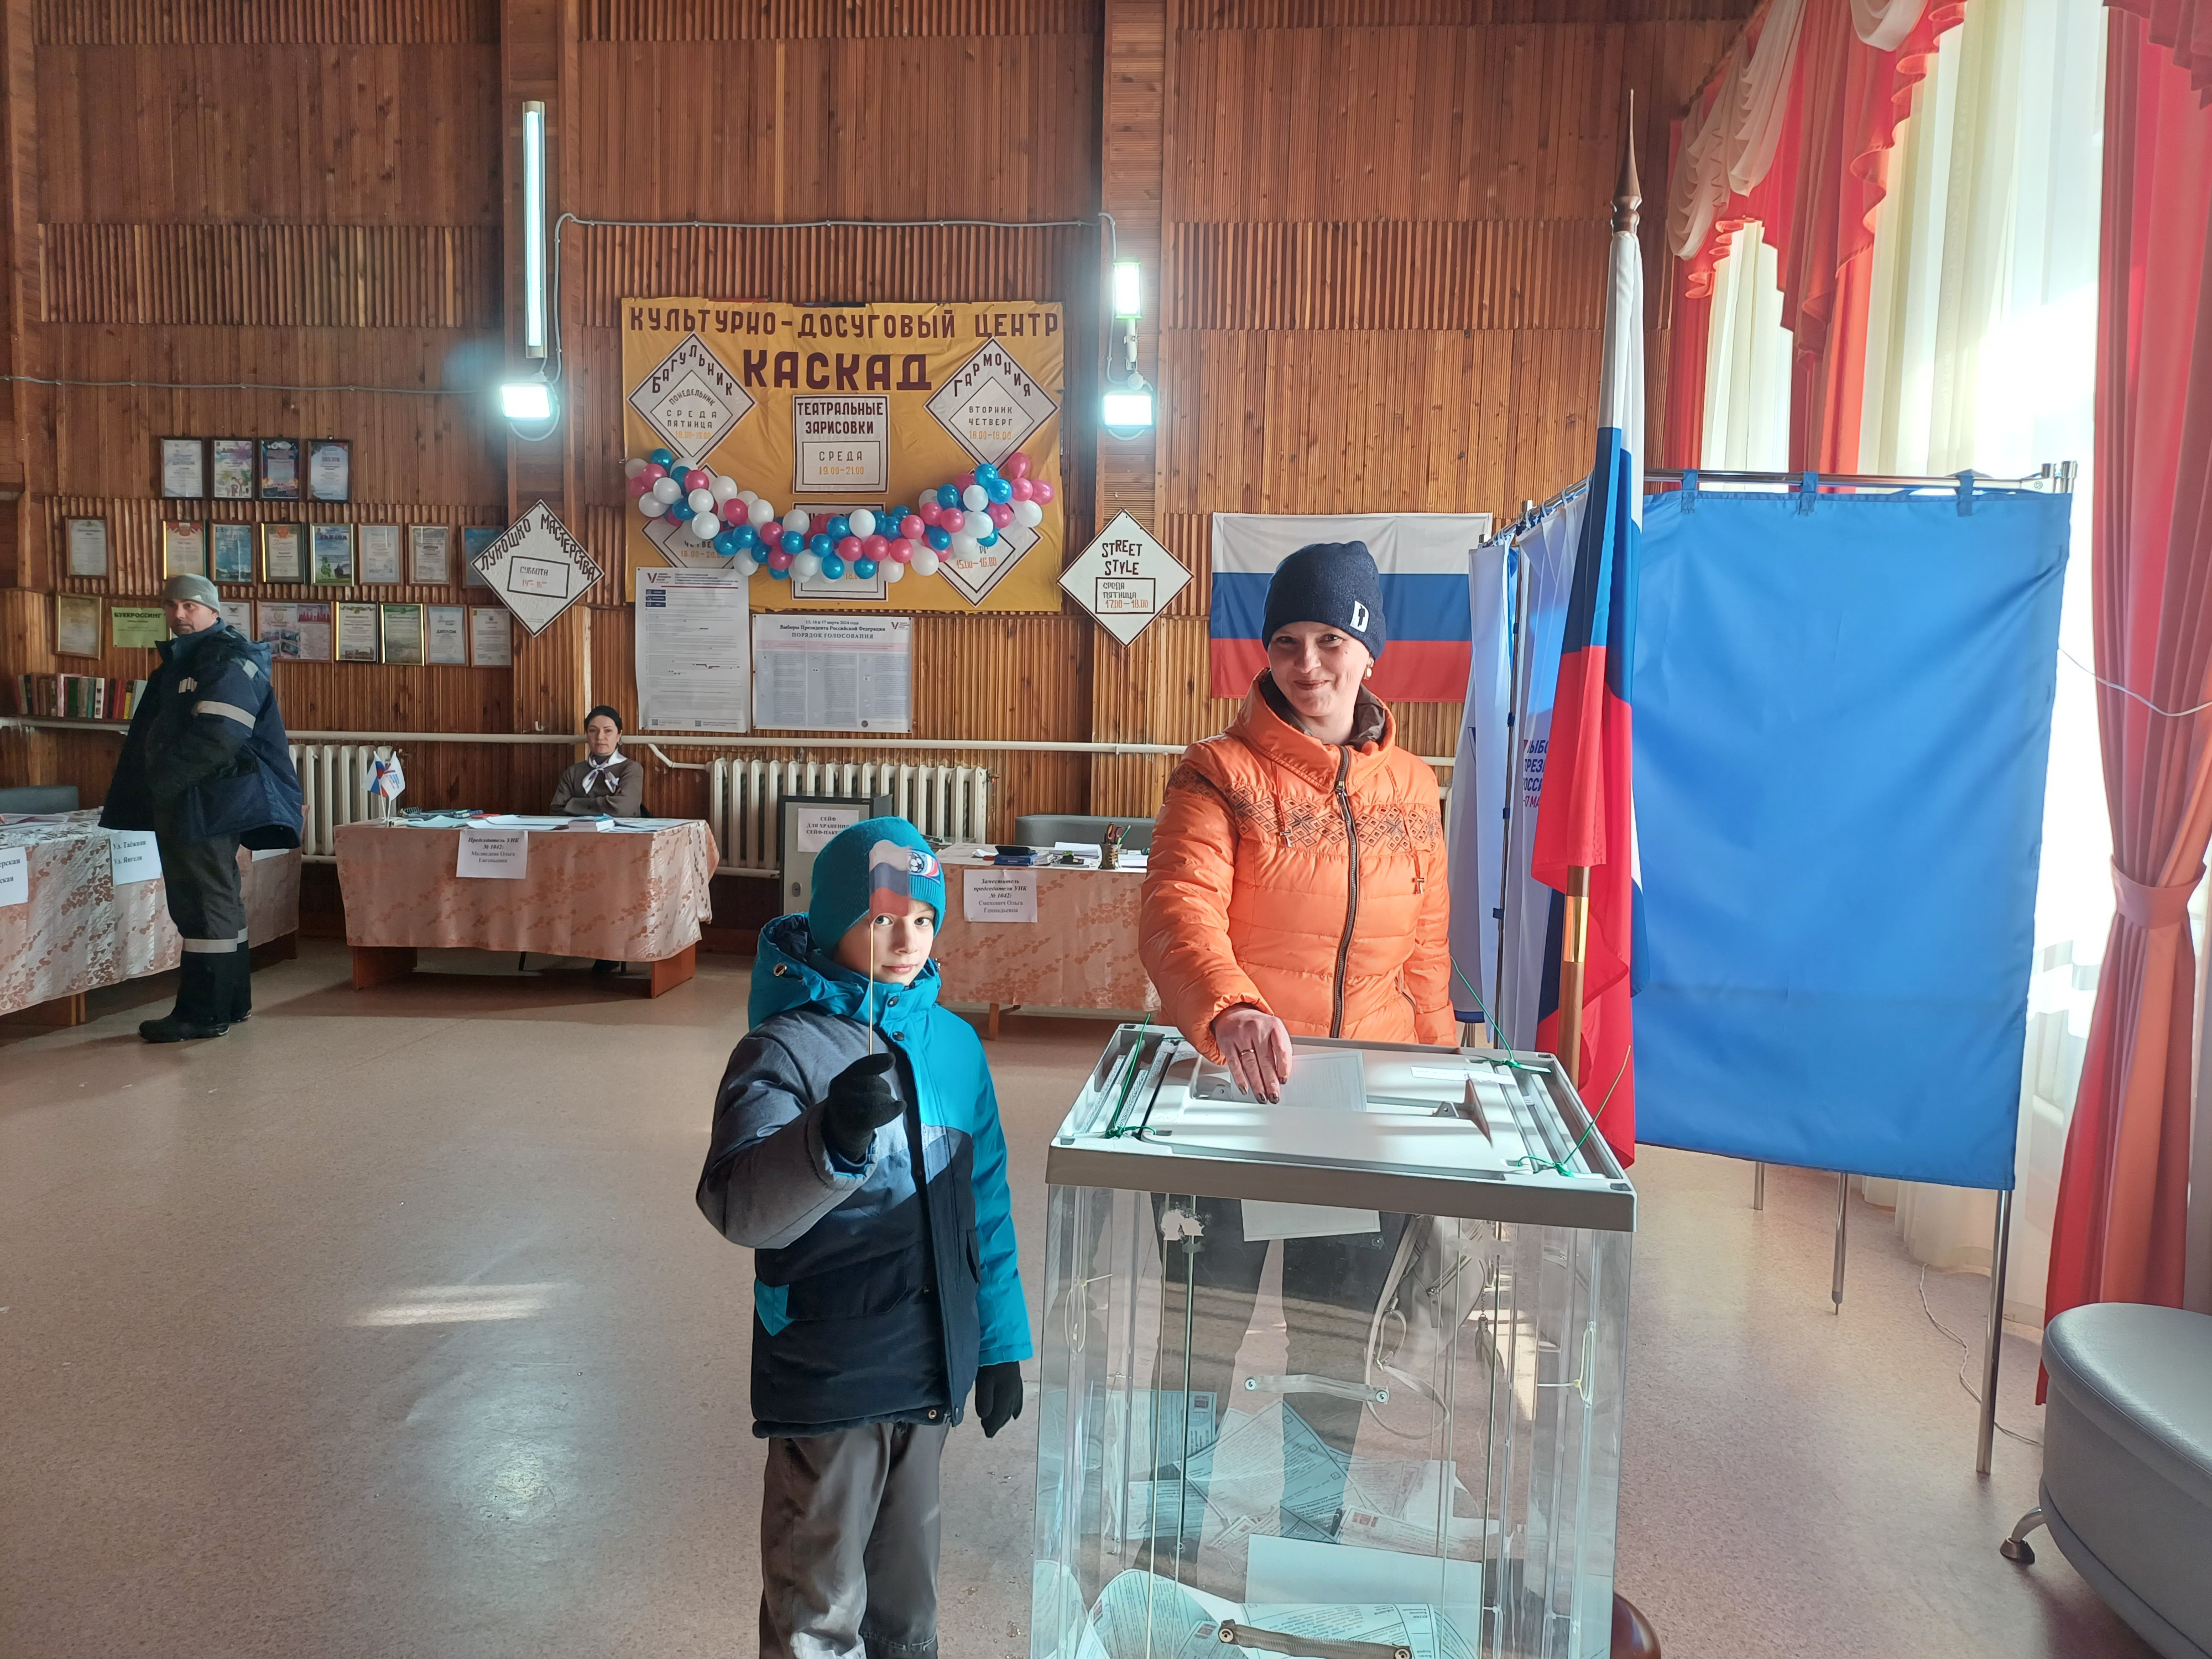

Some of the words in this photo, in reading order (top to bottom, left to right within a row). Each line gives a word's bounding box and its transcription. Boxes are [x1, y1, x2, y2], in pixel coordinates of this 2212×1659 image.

[975, 312, 1058, 340] ЦЕНТР
[652, 345, 732, 395] БАГУЛЬНИК
[743, 349, 932, 390] КАСКАД
[954, 353, 1031, 397] ГАРМОНИЯ
[669, 389, 716, 406] ПОНЕДЕЛЬНИК
[666, 409, 717, 419] СРЕДА
[797, 402, 883, 415] ТЕАТРАЛЬНЫЕ
[667, 420, 712, 429] ПЯТНИЦА
[805, 421, 874, 434] ЗАРИСОВКИ
[819, 451, 862, 461] СРЕДА
[481, 518, 531, 571] ЛУКОШКО
[540, 513, 595, 581] МАСТЕРСТВА
[1102, 539, 1143, 558] STREET
[1104, 560, 1139, 576] STYLE
[1103, 592, 1136, 600] ПЯТНИЦА
[123, 839, 147, 848] Таёжная
[123, 855, 143, 863] Янгеля
